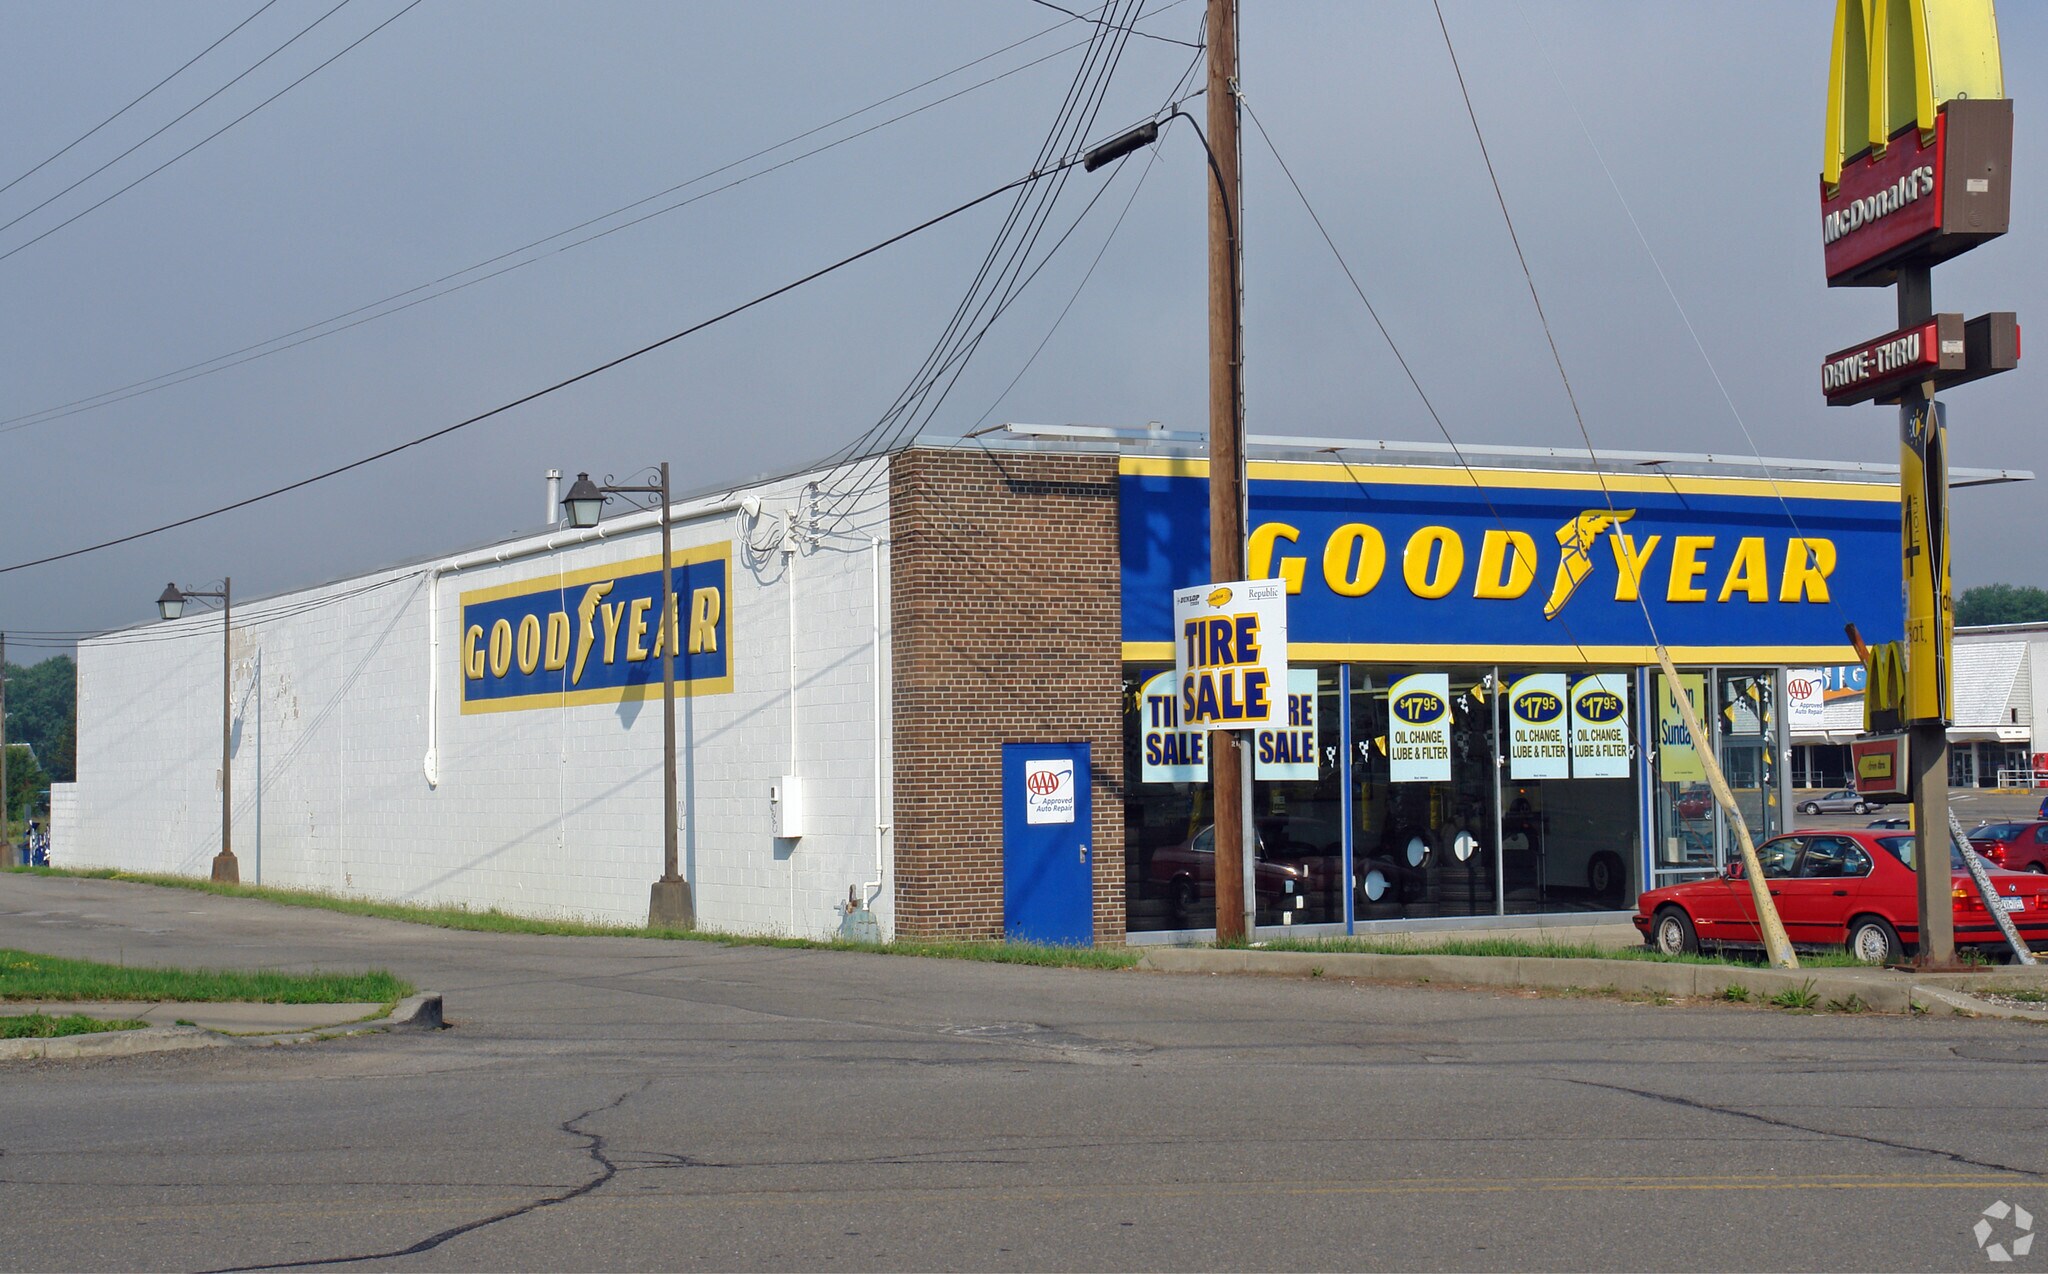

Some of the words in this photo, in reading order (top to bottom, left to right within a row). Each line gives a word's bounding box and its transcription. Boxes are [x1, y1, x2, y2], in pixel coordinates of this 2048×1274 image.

[1824, 165, 1934, 245] McDonald's
[1824, 333, 1920, 391] DRIVE-THRU
[1248, 587, 1279, 600] Republic
[1184, 612, 1262, 670] TIRE
[1183, 667, 1272, 725] SALE
[1790, 679, 1811, 700] AAA
[1807, 708, 1823, 716] Repair
[1395, 731, 1408, 744] OIL
[1409, 731, 1444, 746] CHANGE,
[1515, 730, 1527, 742] OIL
[1529, 729, 1562, 744] CHANGE,
[1577, 729, 1589, 742] OIL
[1591, 729, 1624, 743] CHANGE,
[1146, 731, 1204, 765] SALE
[1259, 730, 1314, 764] SALE
[1392, 747, 1413, 760] LUBE
[1414, 747, 1420, 760] &
[1422, 747, 1448, 760] FILTER
[1512, 746, 1532, 758] LUBE
[1534, 745, 1540, 758] &
[1541, 745, 1566, 758] FILTER
[1574, 745, 1594, 758] LUBE
[1596, 744, 1601, 757] &
[1603, 744, 1627, 757] FILTER
[1031, 771, 1057, 795] AAA
[1036, 805, 1052, 813] Auto
[1053, 804, 1073, 813] Repair
[1042, 797, 1073, 806] Approved
